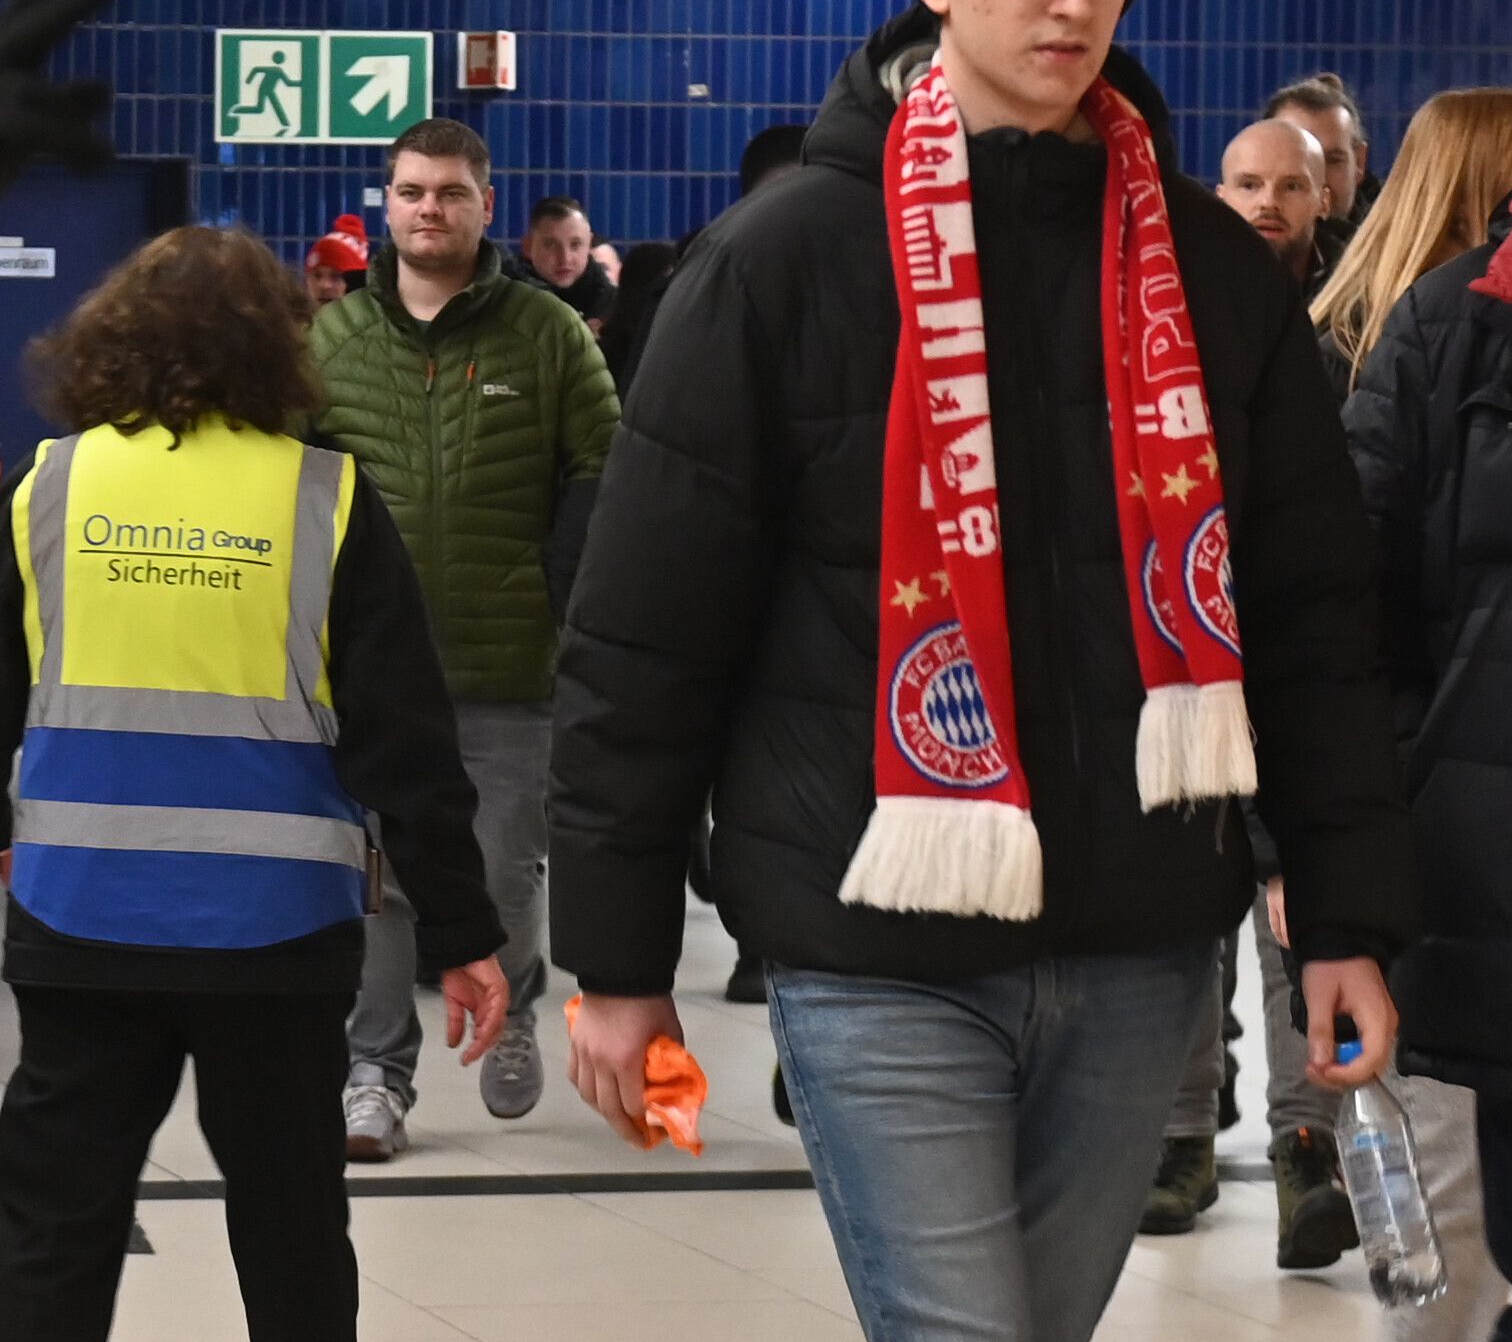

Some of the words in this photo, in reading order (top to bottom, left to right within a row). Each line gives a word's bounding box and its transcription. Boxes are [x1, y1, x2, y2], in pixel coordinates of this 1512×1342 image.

[83, 514, 205, 551] Omnia
[212, 530, 272, 557] Group
[106, 558, 243, 591] Sicherheit
